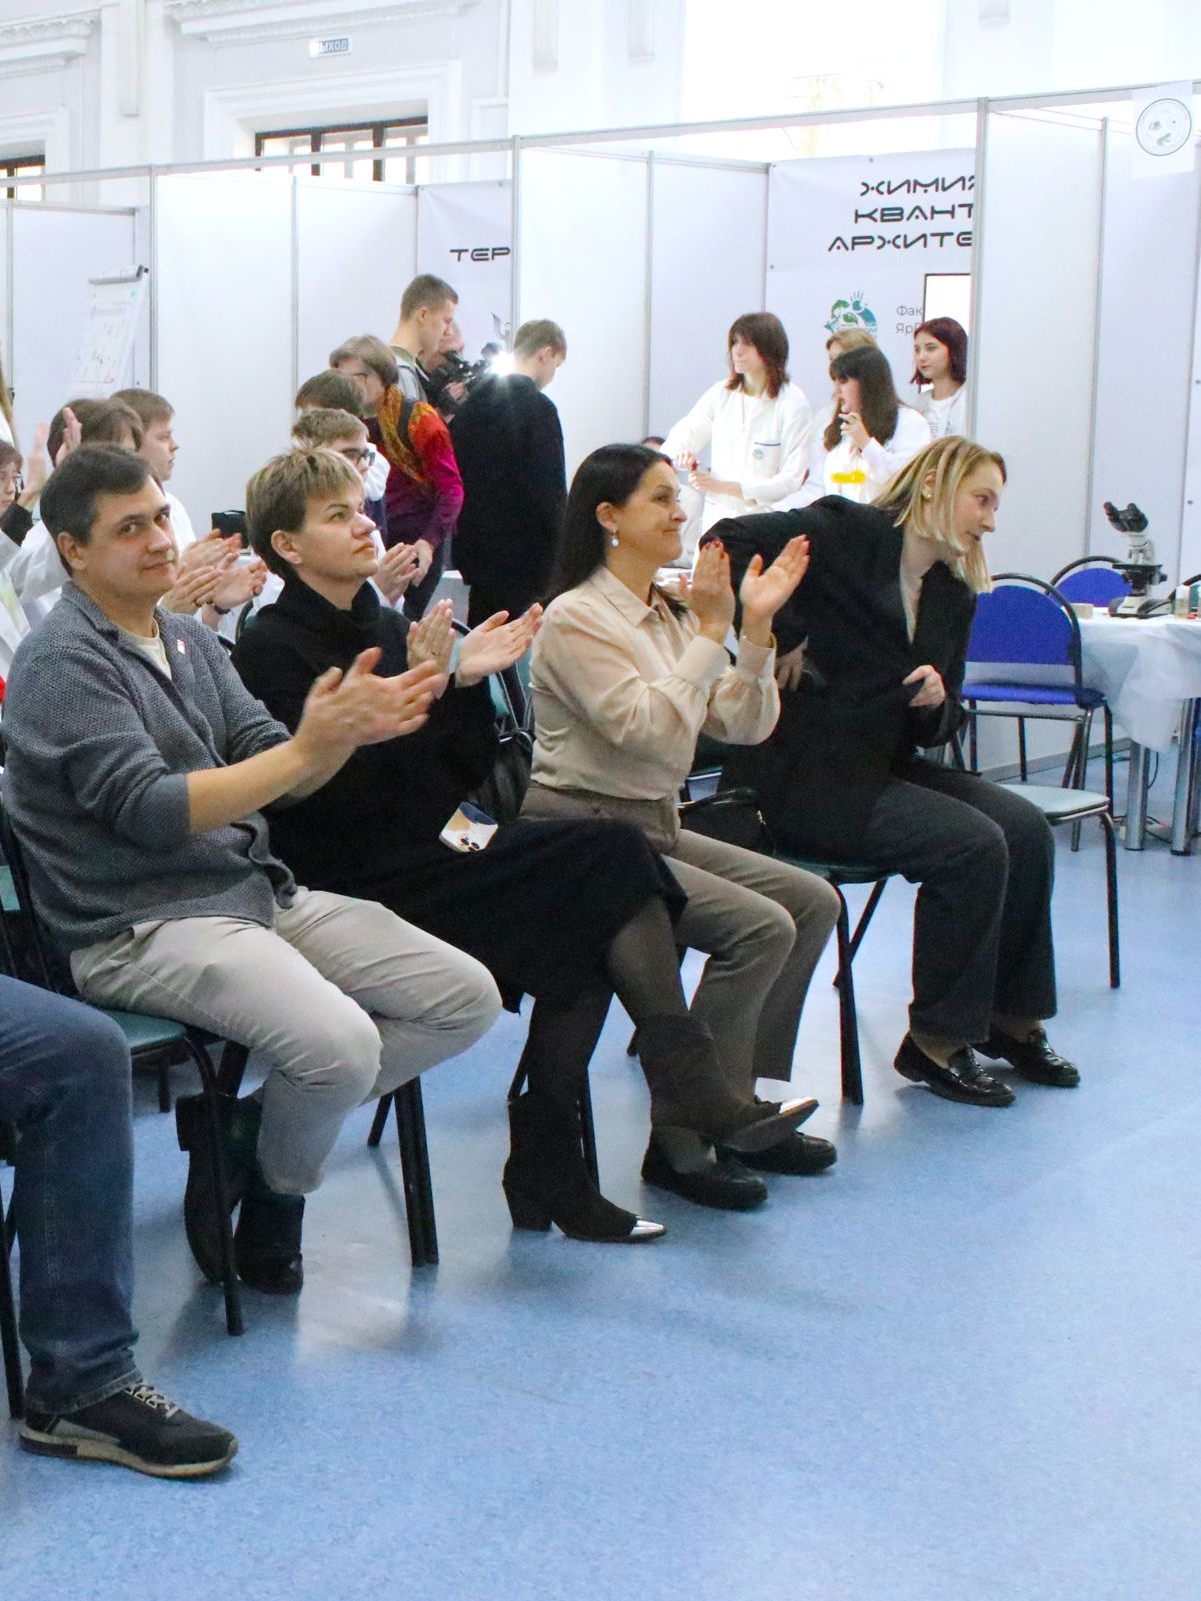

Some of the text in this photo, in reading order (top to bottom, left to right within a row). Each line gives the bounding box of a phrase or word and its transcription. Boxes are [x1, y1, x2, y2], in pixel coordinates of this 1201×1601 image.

[318, 39, 347, 52] ЫХОД
[828, 231, 973, 251] АРХИТЕ
[449, 246, 511, 262] ТЕР
[896, 305, 923, 317] Фак
